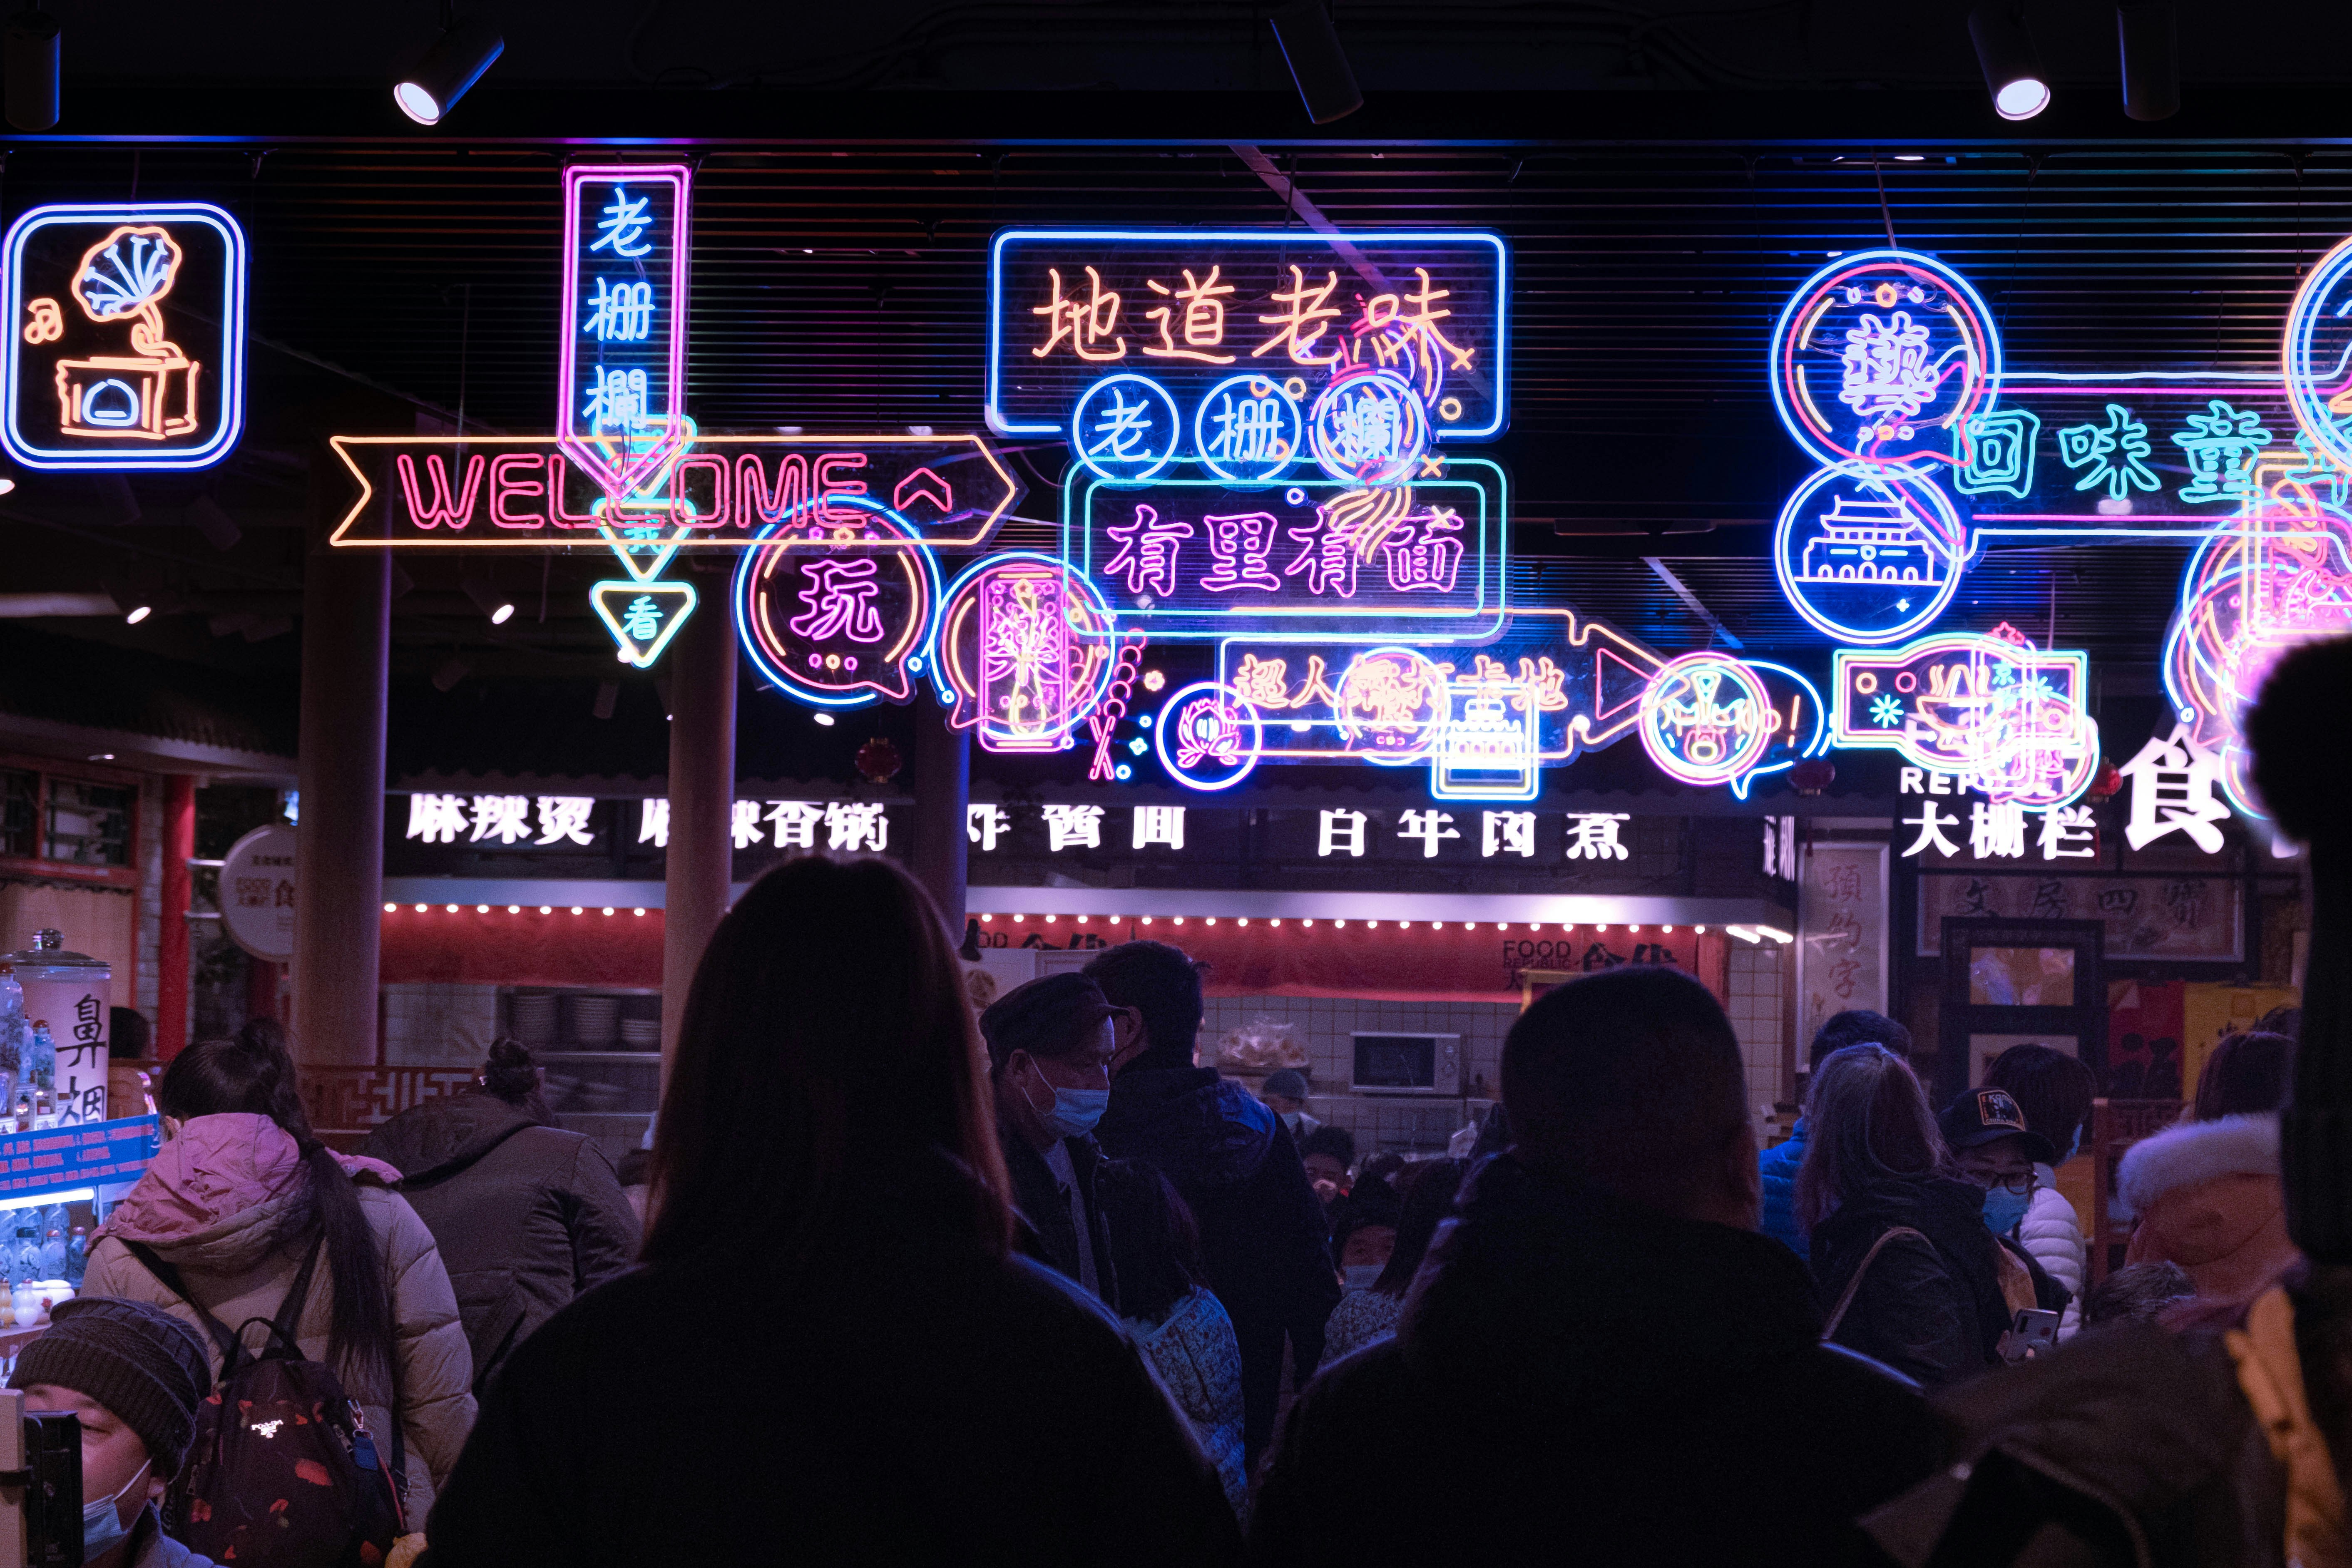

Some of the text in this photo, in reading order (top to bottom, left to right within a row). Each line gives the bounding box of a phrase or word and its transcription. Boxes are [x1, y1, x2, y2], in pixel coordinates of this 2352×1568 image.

[1032, 265, 1462, 365] 地道老味
[398, 453, 867, 529] WELCOME
[790, 559, 884, 642] 玩
[405, 793, 595, 846] 麻辣烫
[1901, 800, 2097, 860] 大栅栏
[1503, 940, 1571, 959] FOOD
